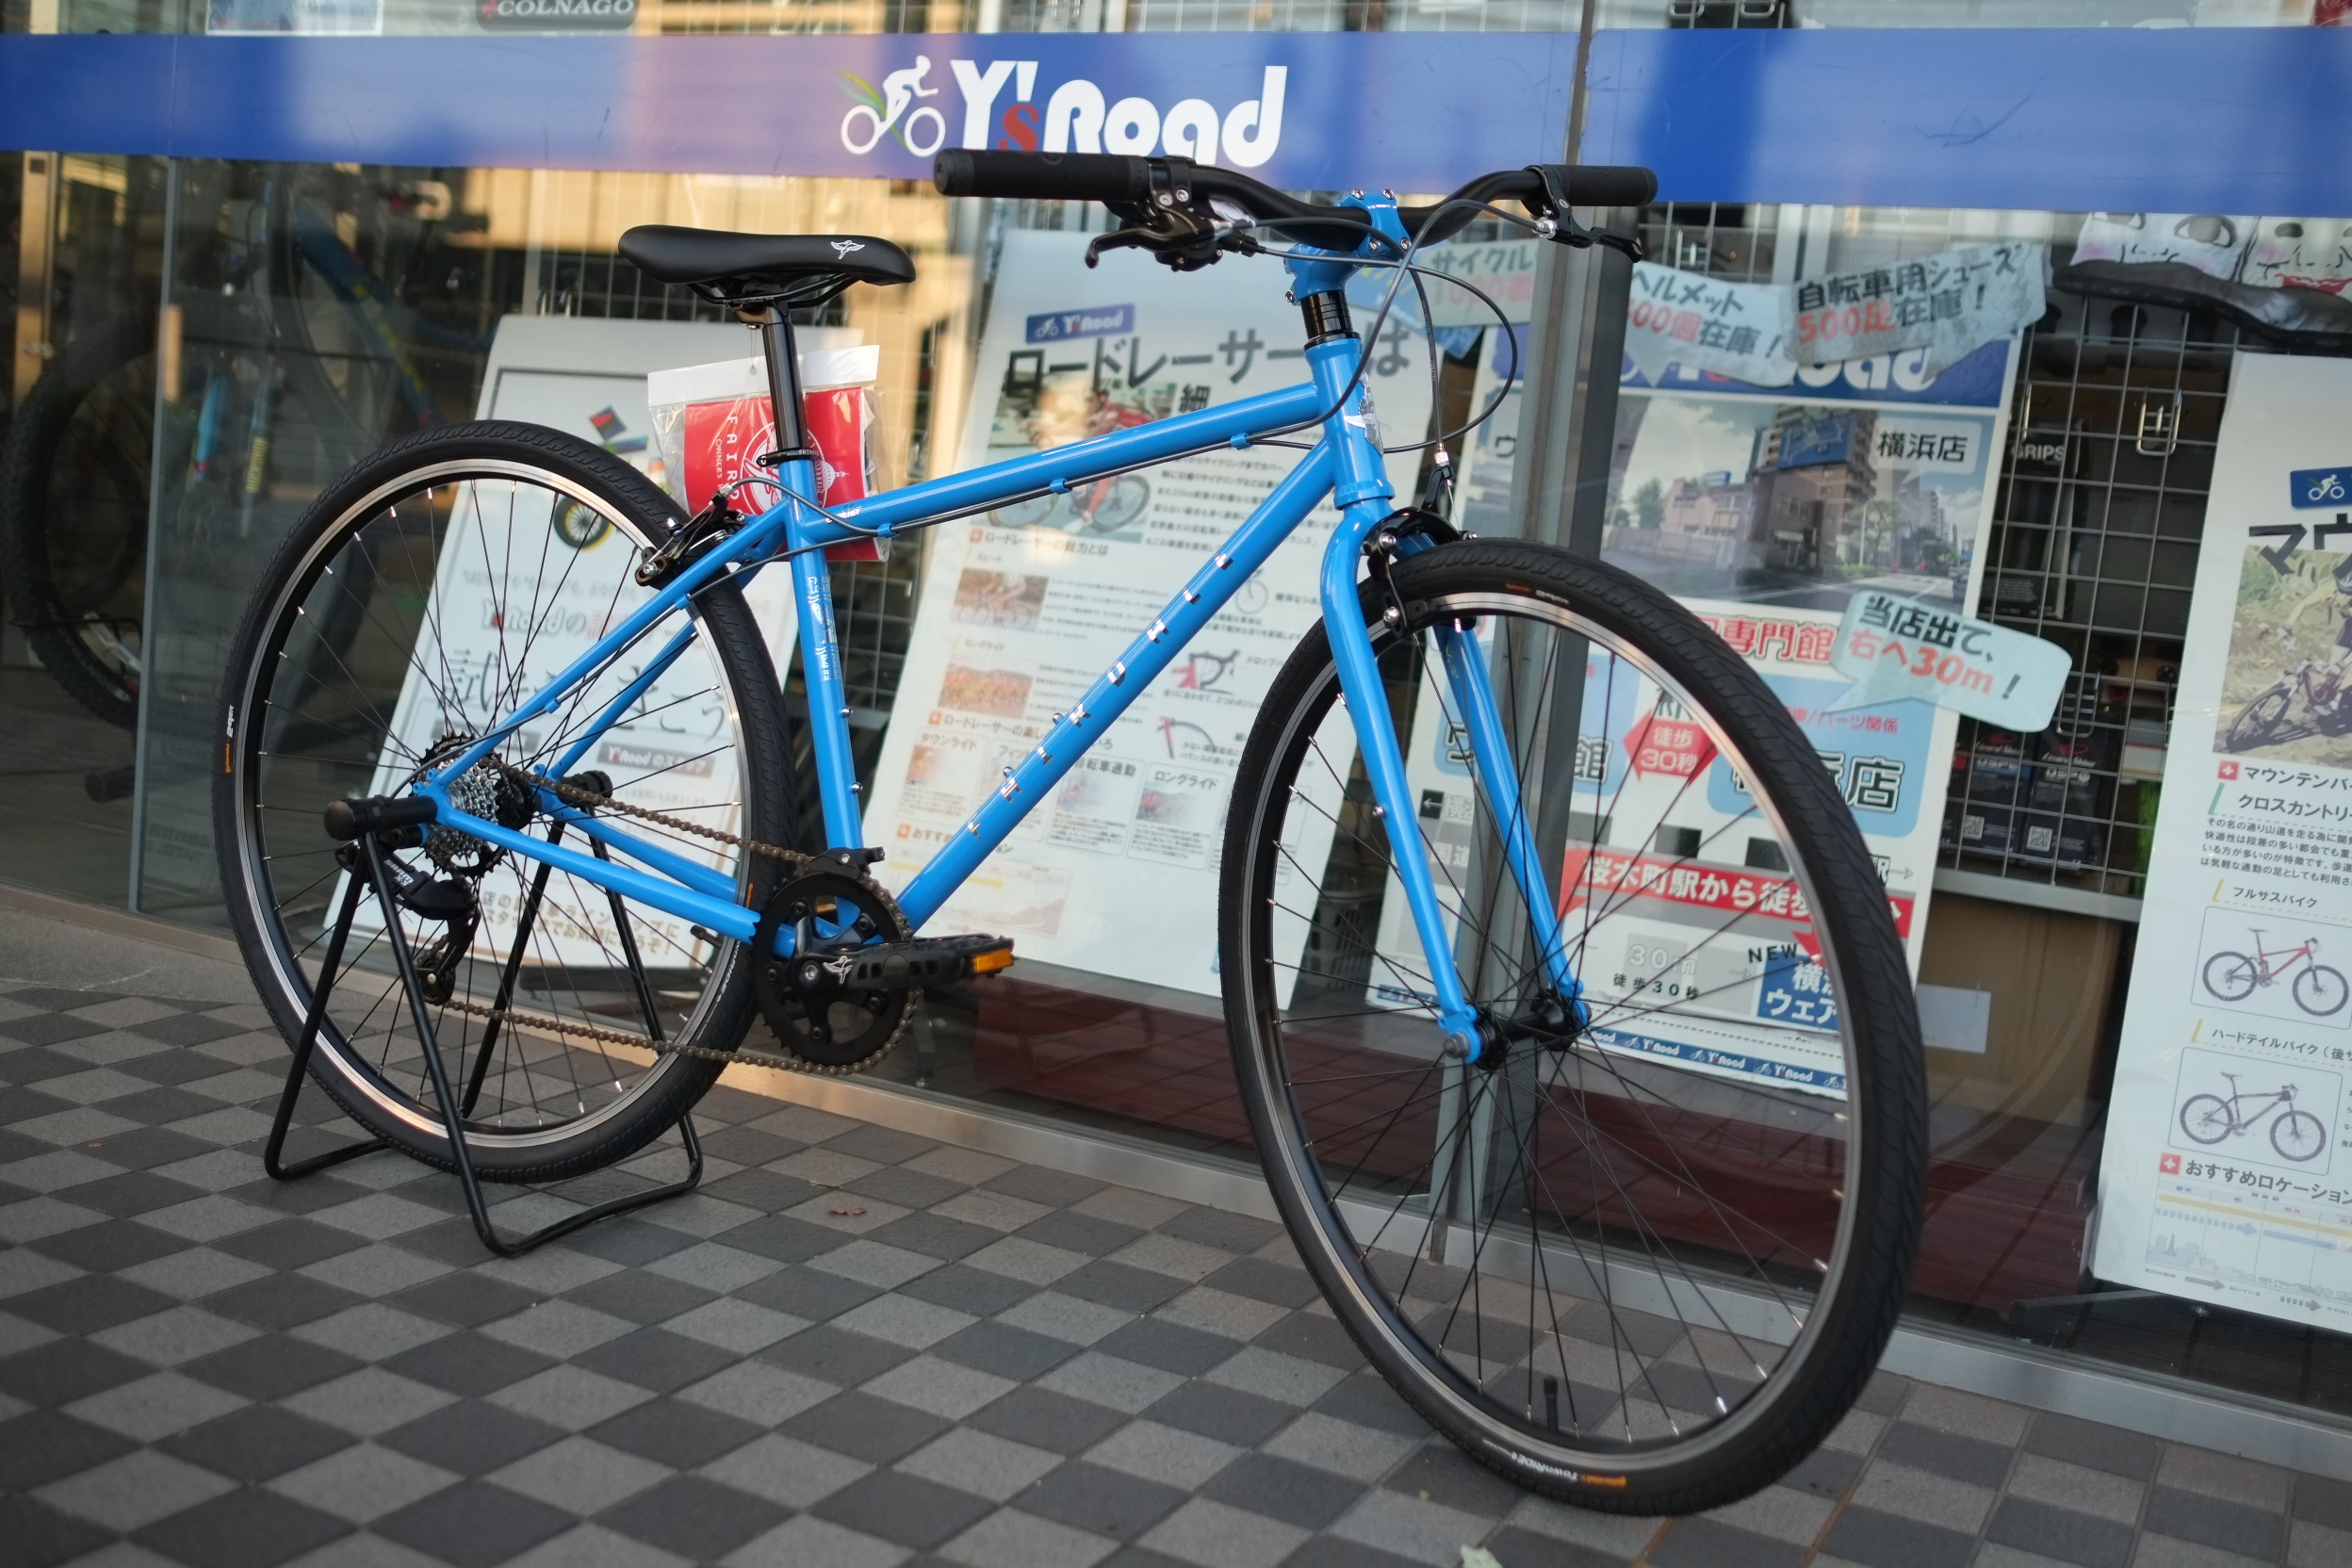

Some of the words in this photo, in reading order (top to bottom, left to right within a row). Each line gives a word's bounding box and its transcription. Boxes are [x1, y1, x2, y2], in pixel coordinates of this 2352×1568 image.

[497, 0, 635, 16] COLNAGO
[1798, 244, 2022, 312] 自転車用シューズ
[1629, 300, 1783, 358] 00個在庫！
[1877, 431, 1969, 462] 横浜店
[2011, 442, 2066, 462] GRIPS
[1704, 614, 1838, 664] 専門館
[1859, 596, 1993, 662] 当店出て、
[1652, 725, 1693, 749] 徒歩
[1641, 748, 1698, 774] 30秒
[2244, 765, 2352, 792] マウンテンバ
[2238, 793, 2352, 823] クロスカントリ
[2232, 886, 2318, 909] フルサスバイク
[1748, 943, 1798, 963] NEW
